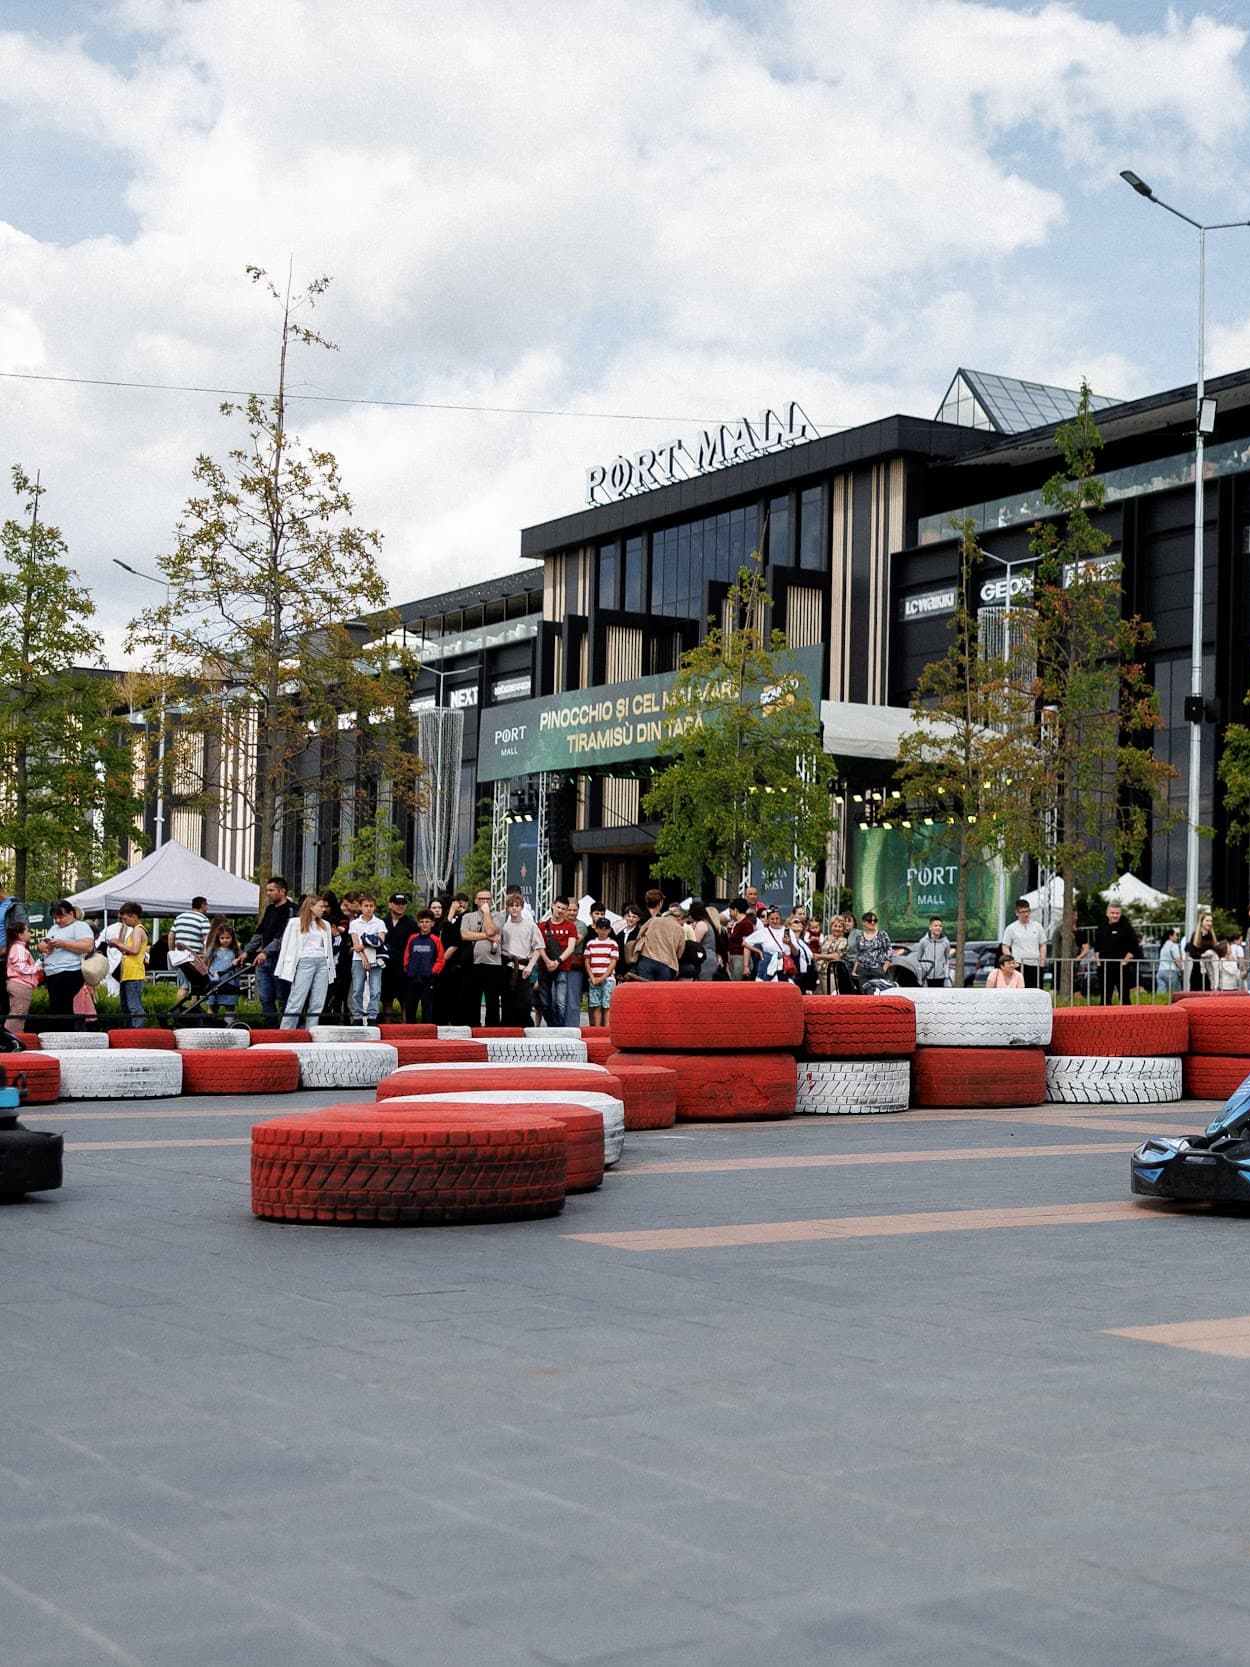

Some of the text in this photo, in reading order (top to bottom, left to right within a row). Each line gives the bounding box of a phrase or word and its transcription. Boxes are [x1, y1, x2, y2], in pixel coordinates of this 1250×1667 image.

[585, 401, 810, 504] PORT MALL
[450, 686, 478, 708] NEXT
[540, 700, 613, 731] PINOCCHIO
[616, 697, 629, 722] ȘI
[632, 692, 660, 715] CEL
[494, 724, 527, 745] PORT
[566, 721, 633, 753] TIRAMISÙ
[637, 720, 662, 743] DIN
[501, 746, 518, 757] MALL
[906, 866, 958, 887] PORT
[917, 894, 944, 905] MALL
